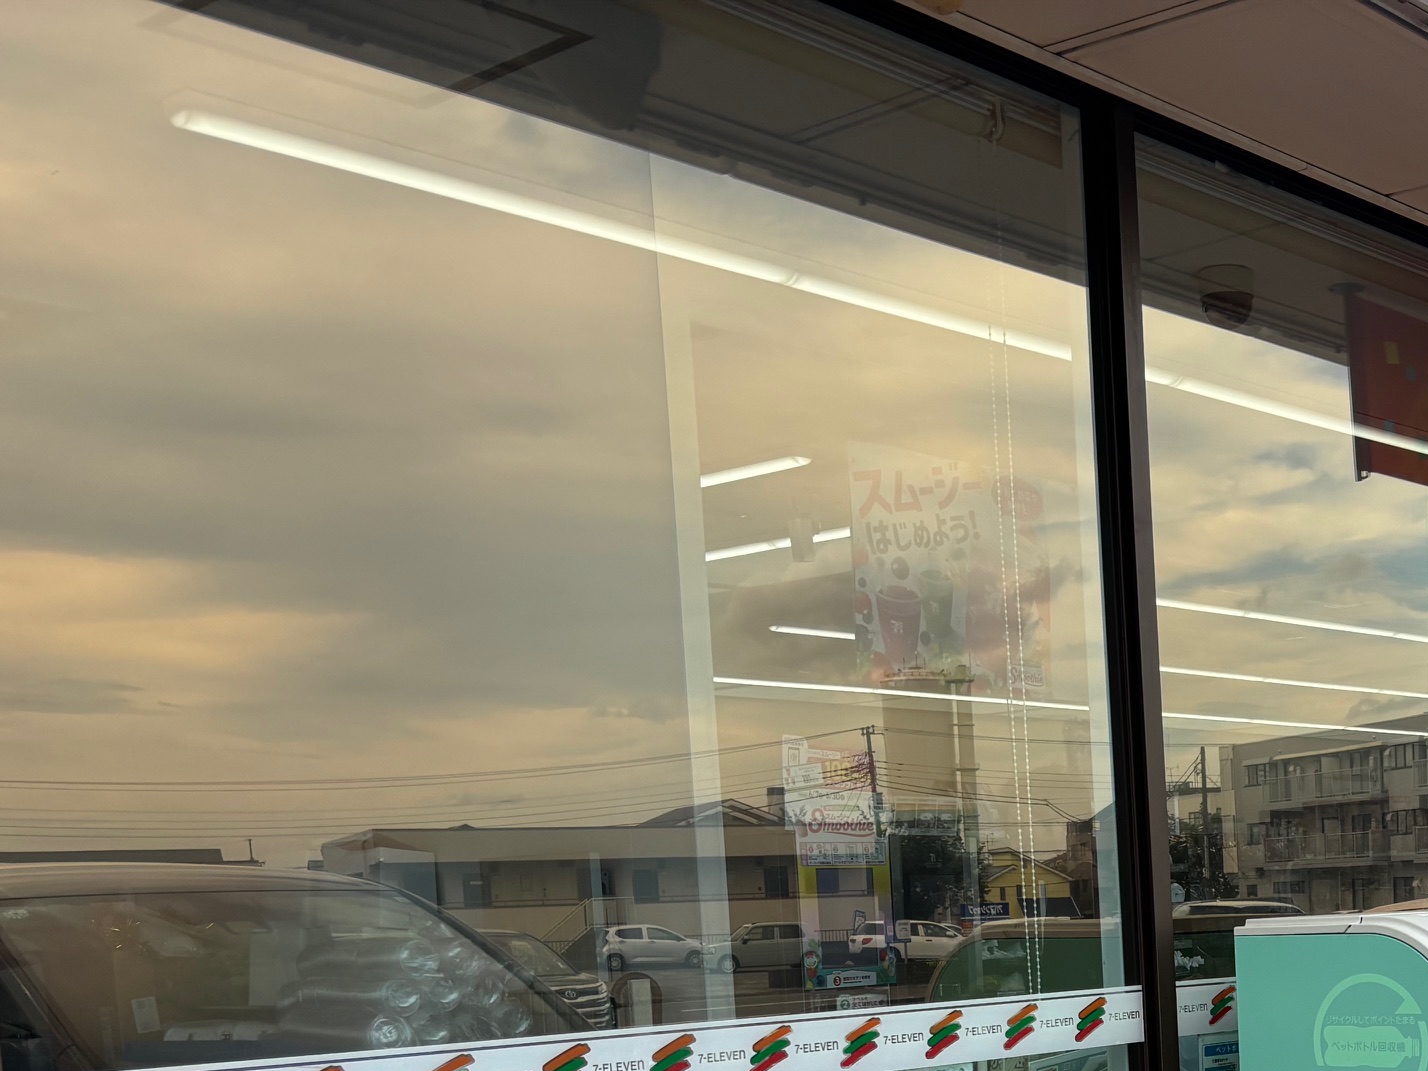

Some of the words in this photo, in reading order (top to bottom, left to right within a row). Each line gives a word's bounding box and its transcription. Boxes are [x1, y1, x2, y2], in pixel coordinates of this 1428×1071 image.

[853, 460, 984, 519] スムージー
[865, 509, 980, 555] はじめよう!
[807, 807, 875, 834] Smoothie
